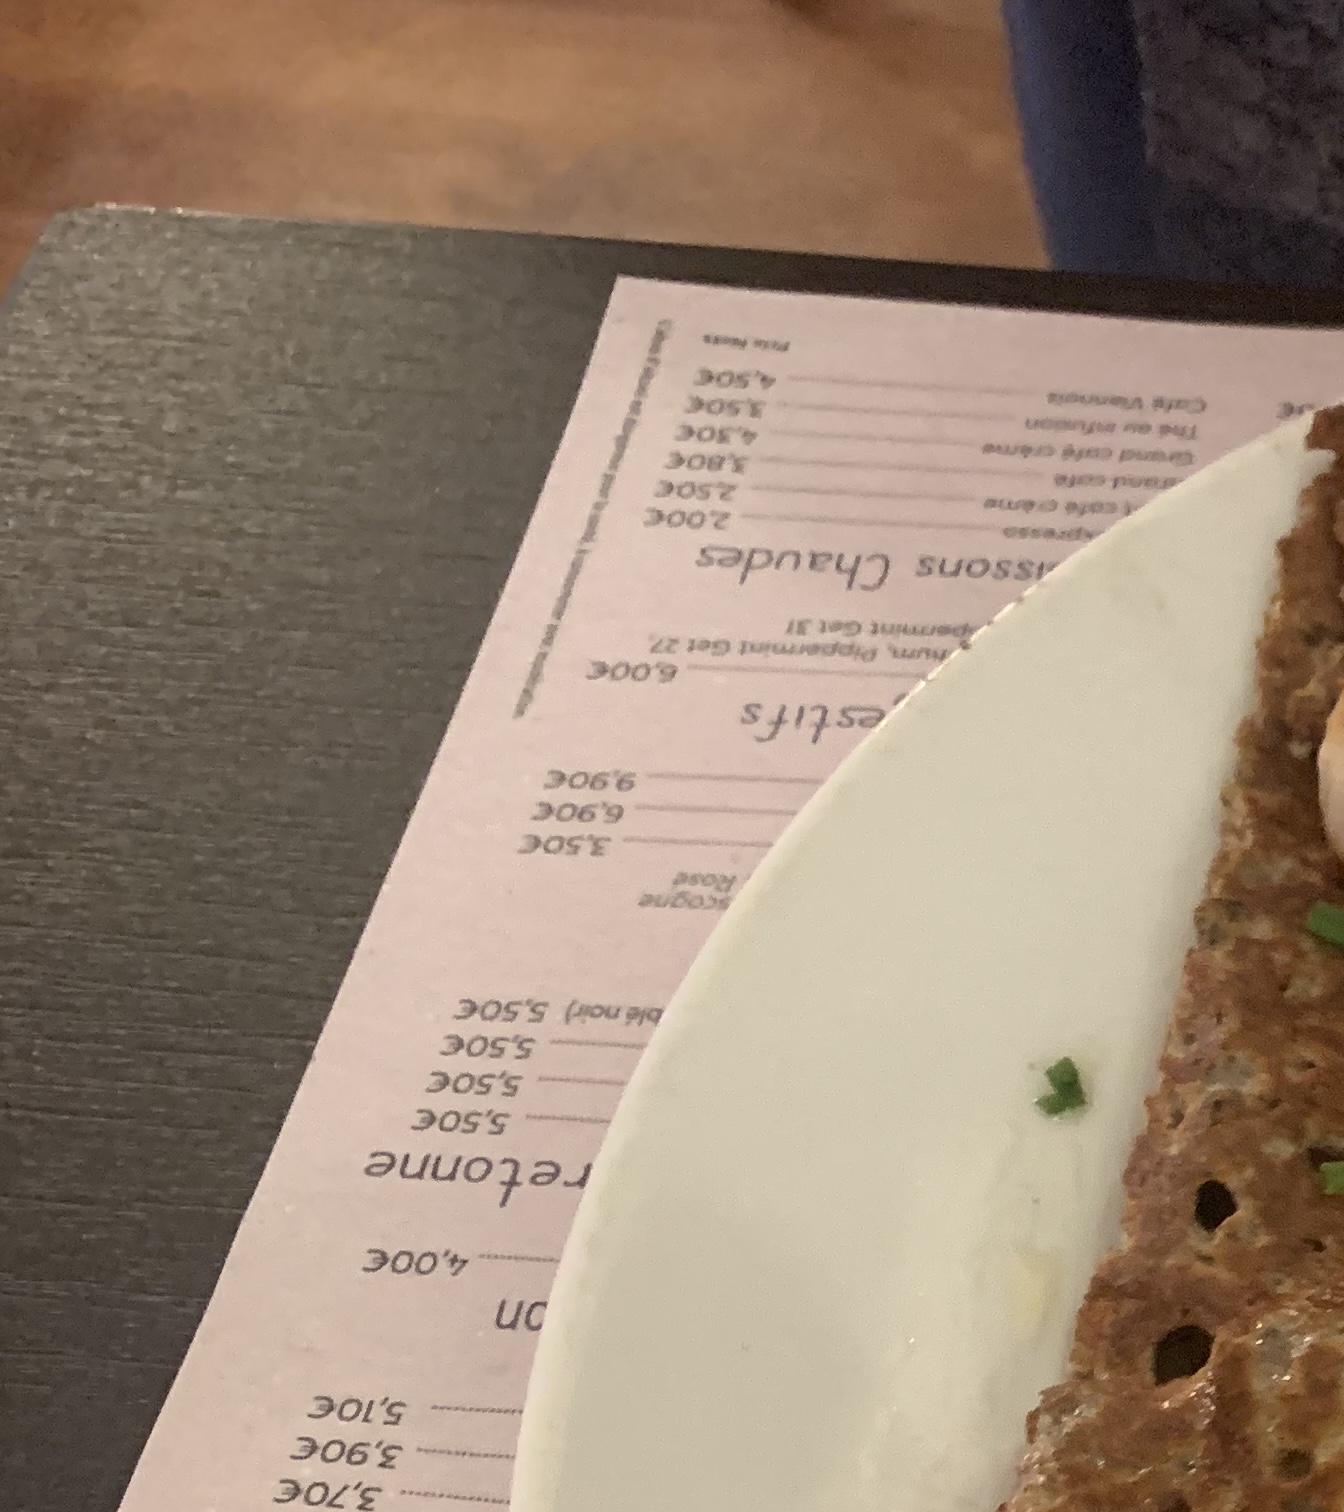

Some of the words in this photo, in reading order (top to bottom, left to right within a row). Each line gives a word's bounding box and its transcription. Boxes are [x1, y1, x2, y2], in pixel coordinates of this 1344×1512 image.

[694, 544, 890, 593] Chaudes
[739, 698, 896, 745] estifs
[542, 768, 636, 793] 9,90€
[529, 800, 625, 824] 6,90€
[516, 833, 612, 857] 3,50€
[452, 997, 550, 1023] 5,50€
[439, 1033, 536, 1060] 5,50€
[425, 1070, 524, 1098] 5,50€
[410, 1108, 511, 1136] 5,50€
[363, 1150, 593, 1209] retonne
[360, 1247, 470, 1277] 4,00€
[306, 1395, 408, 1427] 5,10€
[289, 1436, 404, 1471] 3,90€
[272, 1478, 384, 1512] 3,70€
